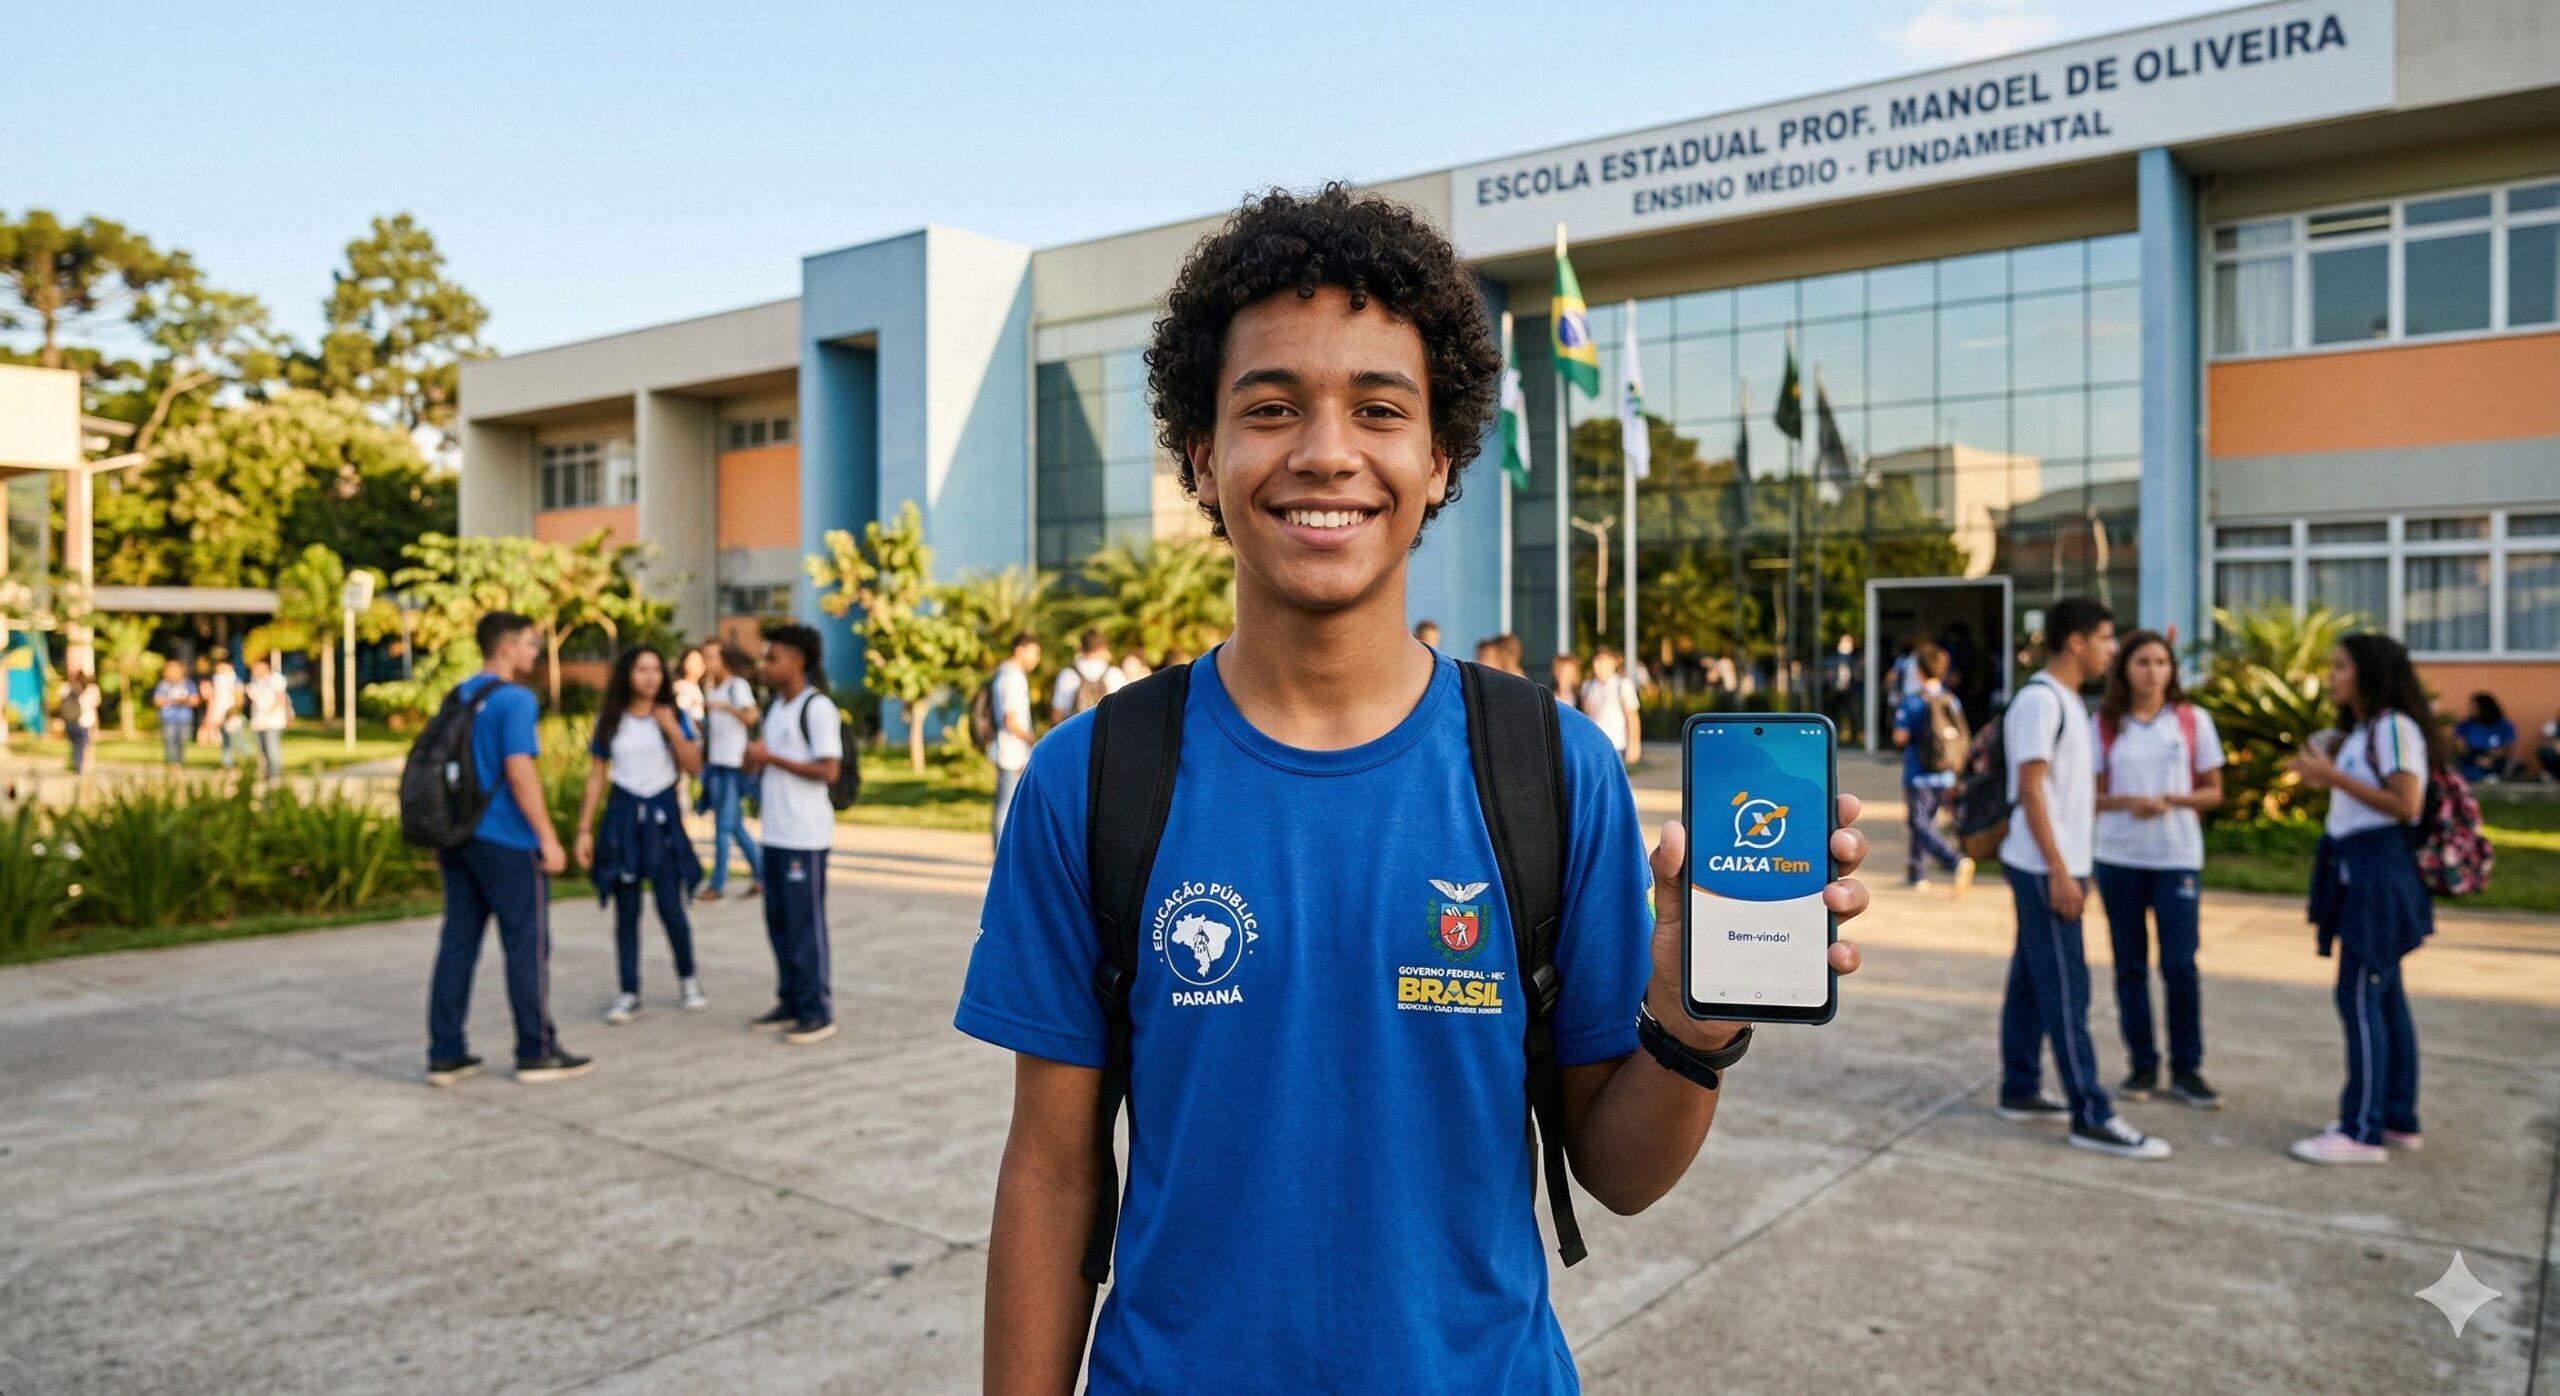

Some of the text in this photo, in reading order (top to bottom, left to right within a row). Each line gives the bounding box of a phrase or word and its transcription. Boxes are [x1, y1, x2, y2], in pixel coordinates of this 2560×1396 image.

[1477, 14, 2347, 206] ESCOLA ESTADUAL PROF. MANOEL DE OLIVEIRA
[1633, 176, 1734, 216] ENSINO
[1745, 158, 1838, 196] MÉDIO
[1868, 110, 2112, 175] FUNDAMENTAL
[1709, 855, 1810, 873] CAIXA Tem
[1152, 881, 1259, 951] EDUCAÇÃO PÚBLICA
[1728, 930, 1790, 943] Bem-vindo!
[1399, 966, 1444, 976] GOVERNO
[1446, 969, 1485, 979] FEDERAL
[1172, 985, 1243, 1006] PARANÁ
[1398, 977, 1502, 1006] BRASIL
